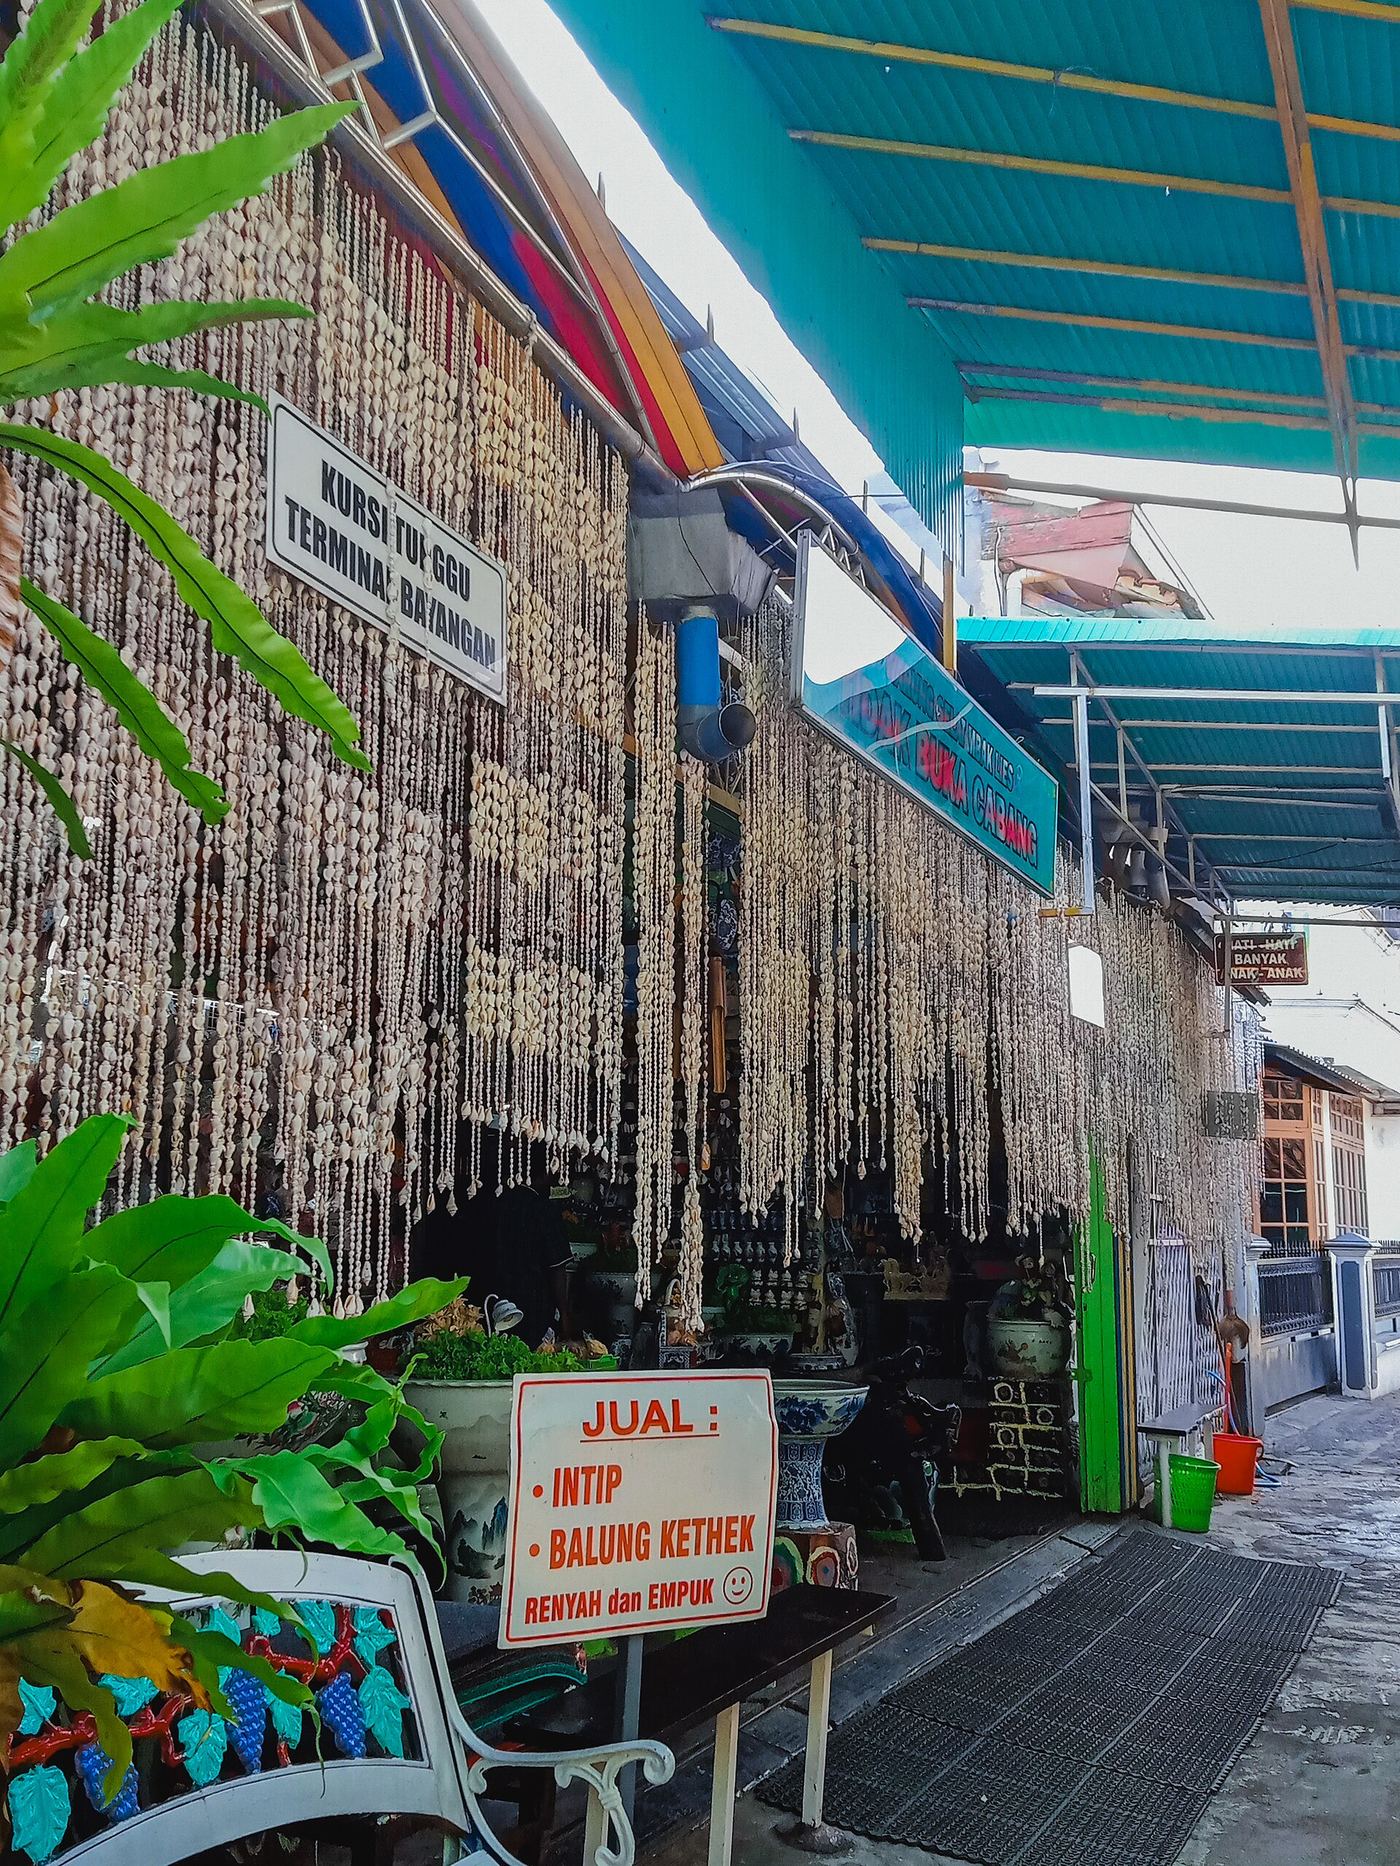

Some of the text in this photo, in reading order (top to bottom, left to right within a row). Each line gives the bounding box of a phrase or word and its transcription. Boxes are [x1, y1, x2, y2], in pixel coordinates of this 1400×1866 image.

[321, 459, 388, 545] KURSI
[400, 575, 496, 673] BAYANGAN
[916, 720, 969, 816] BUKA
[972, 774, 1038, 870] CABANG
[1234, 953, 1287, 965] BANYAK
[582, 1398, 693, 1437] JUAL
[552, 1464, 622, 1508] INTIP
[549, 1514, 756, 1570] BALUNG KETHEK
[524, 1578, 714, 1624] RENYAH dan EMPUK
